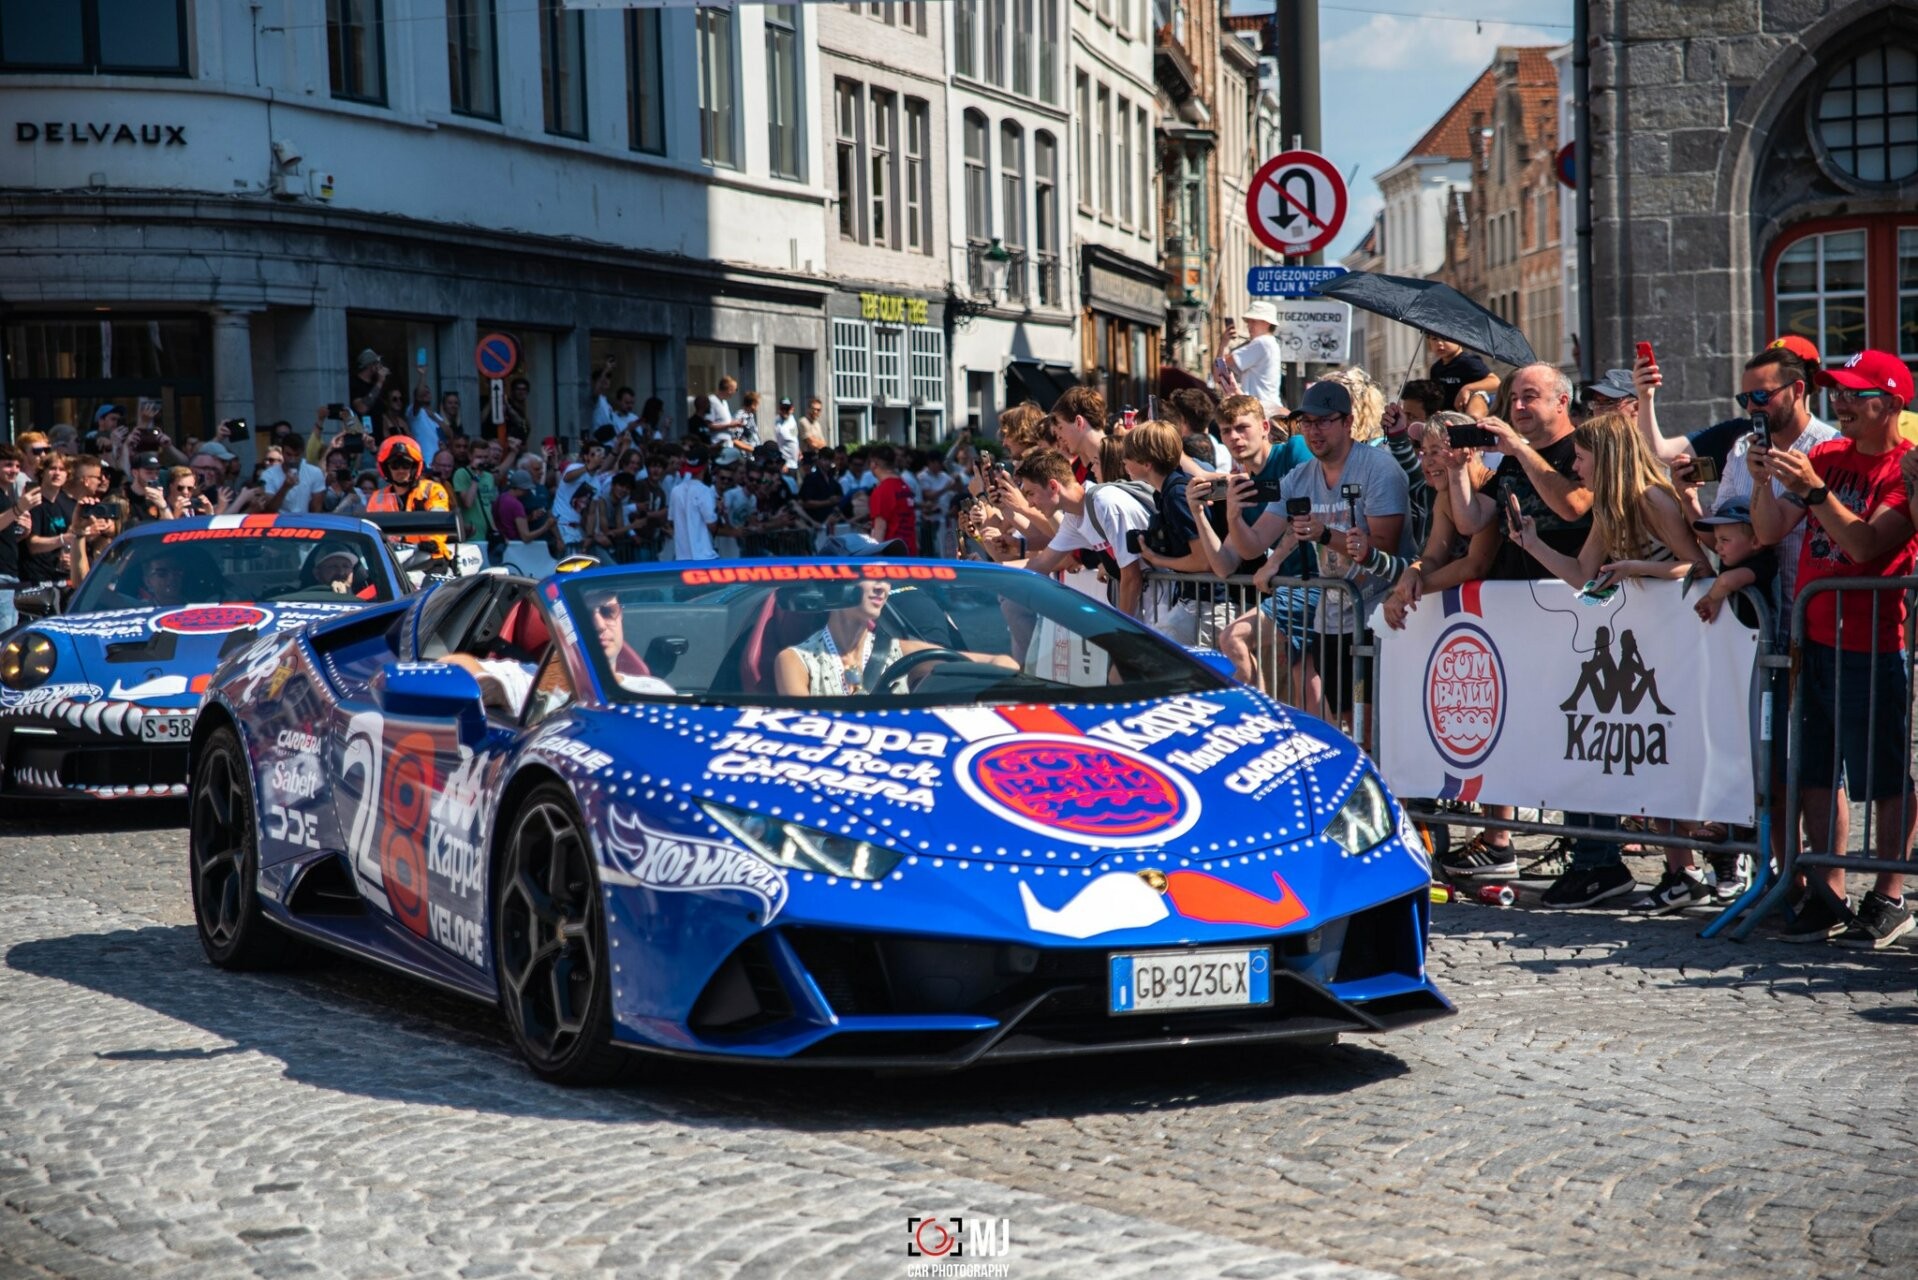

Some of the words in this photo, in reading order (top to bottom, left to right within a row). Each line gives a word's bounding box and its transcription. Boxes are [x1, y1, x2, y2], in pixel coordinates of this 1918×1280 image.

[16, 122, 187, 145] DELVAUX
[1257, 282, 1270, 292] DE
[1273, 282, 1295, 292] LIJN
[1276, 312, 1342, 322] ITGEZONDERD
[162, 528, 264, 543] GUMBALL
[266, 528, 326, 539] 3000
[681, 565, 859, 585] GUMBALL
[861, 565, 957, 580] 3000
[1436, 650, 1492, 680] GUM
[1435, 681, 1493, 709] BALL
[145, 719, 156, 738] S
[277, 729, 321, 755] CARRERA
[732, 706, 949, 758] Kappa
[1086, 698, 1226, 752] Kappa
[1166, 733, 1238, 774] Hard
[1213, 713, 1286, 745] Rock
[1437, 710, 1493, 740] 3000
[711, 731, 838, 764] Hard
[832, 750, 942, 787] Rock
[1224, 732, 1331, 794] CARRERA
[1563, 713, 1670, 776] Kappa
[272, 761, 317, 799] Sabelt
[707, 752, 936, 808] CARRERA
[343, 711, 435, 938] 28
[429, 819, 483, 898] Kappa
[428, 902, 483, 967] VELOCE
